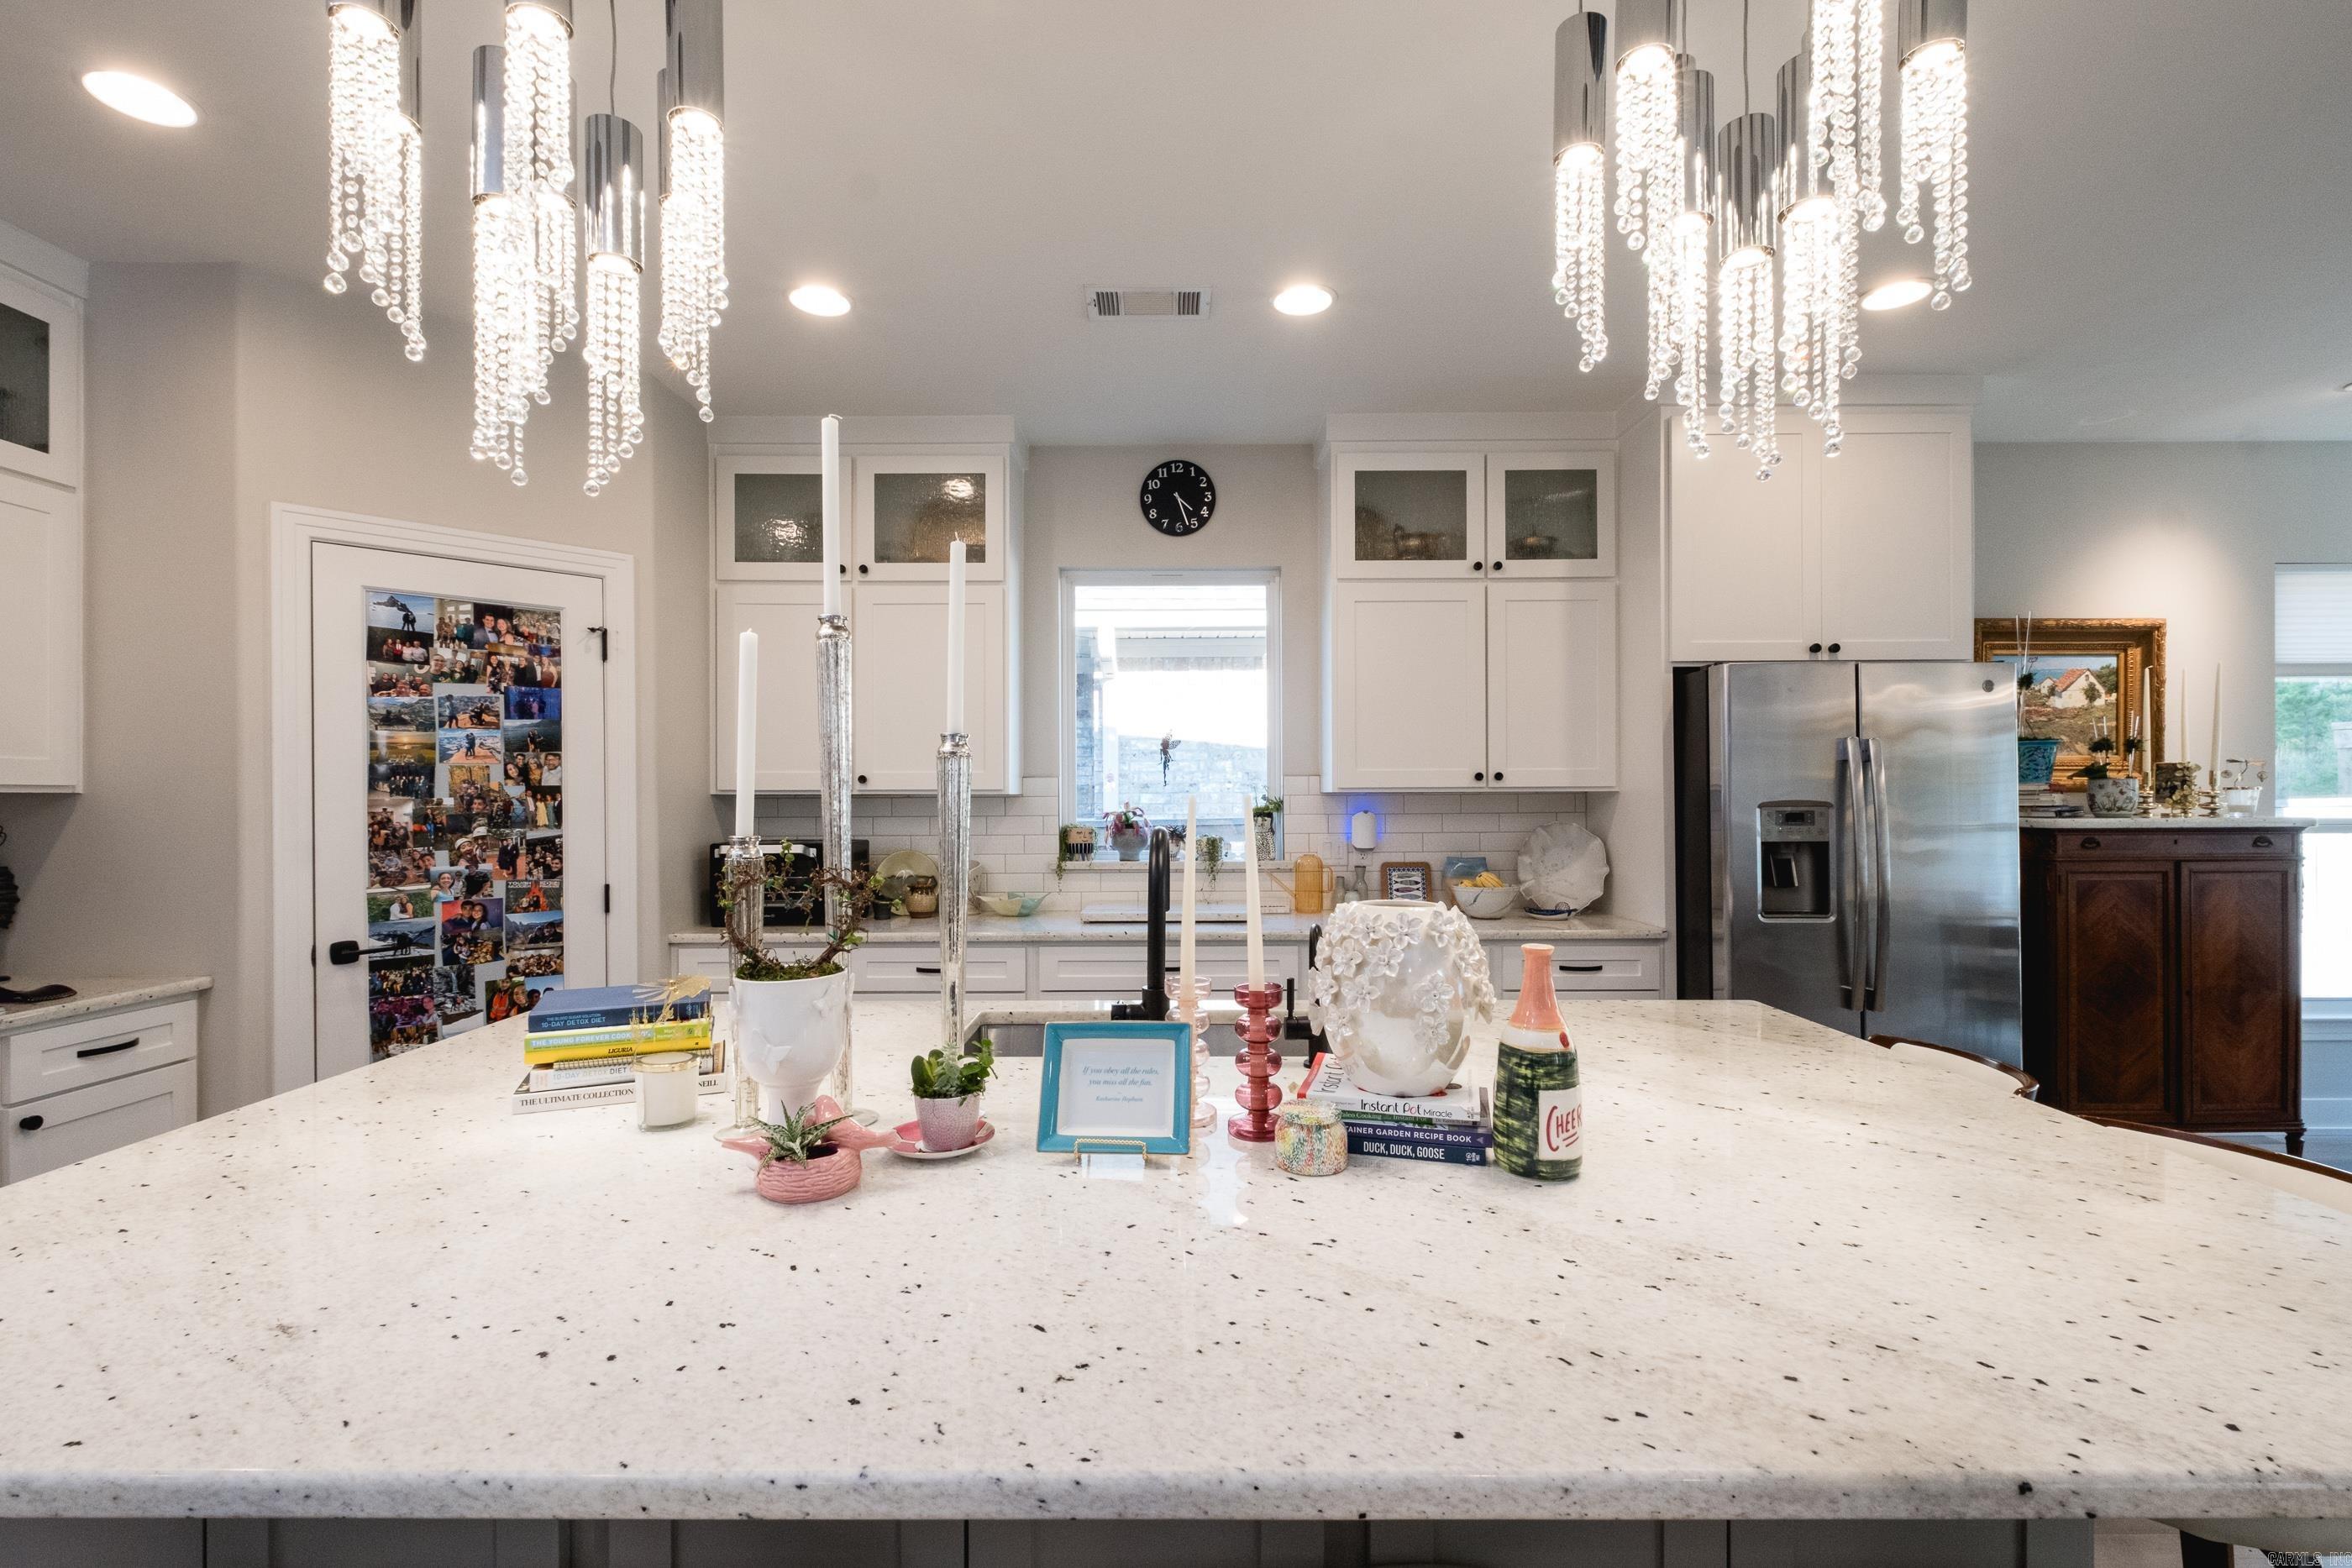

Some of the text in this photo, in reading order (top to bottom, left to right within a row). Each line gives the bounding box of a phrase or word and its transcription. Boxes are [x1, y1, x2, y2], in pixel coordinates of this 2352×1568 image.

[1158, 468, 1168, 478] 11
[1170, 463, 1184, 473] 12
[1189, 466, 1195, 476] 1
[1147, 480, 1160, 490] 10
[1200, 476, 1207, 486] 2
[1144, 494, 1152, 504] 9
[1205, 491, 1212, 501] 3
[1149, 508, 1157, 519] 8
[1200, 506, 1209, 517] 4
[1161, 519, 1169, 529] 7
[1175, 522, 1183, 532] 6
[1190, 517, 1198, 528] 5
[549, 1036, 575, 1045] YOUNG
[576, 1033, 610, 1042] FOREVER
[609, 1067, 627, 1075] DIET
[1104, 1067, 1119, 1076] obey
[538, 1093, 581, 1104] ULTIMATE
[583, 1088, 634, 1100] COLLECTION
[1361, 1099, 1399, 1114] Instant
[1403, 1102, 1421, 1115] Pot
[1423, 1109, 1452, 1118] Miracle
[1356, 1112, 1382, 1120] Cooking
[1376, 1128, 1411, 1138] GARDEN
[1414, 1131, 1444, 1141] RECIPE
[1446, 1134, 1472, 1143] BOOK
[1363, 1141, 1445, 1160] DUCK, DUCK, GOOSE
